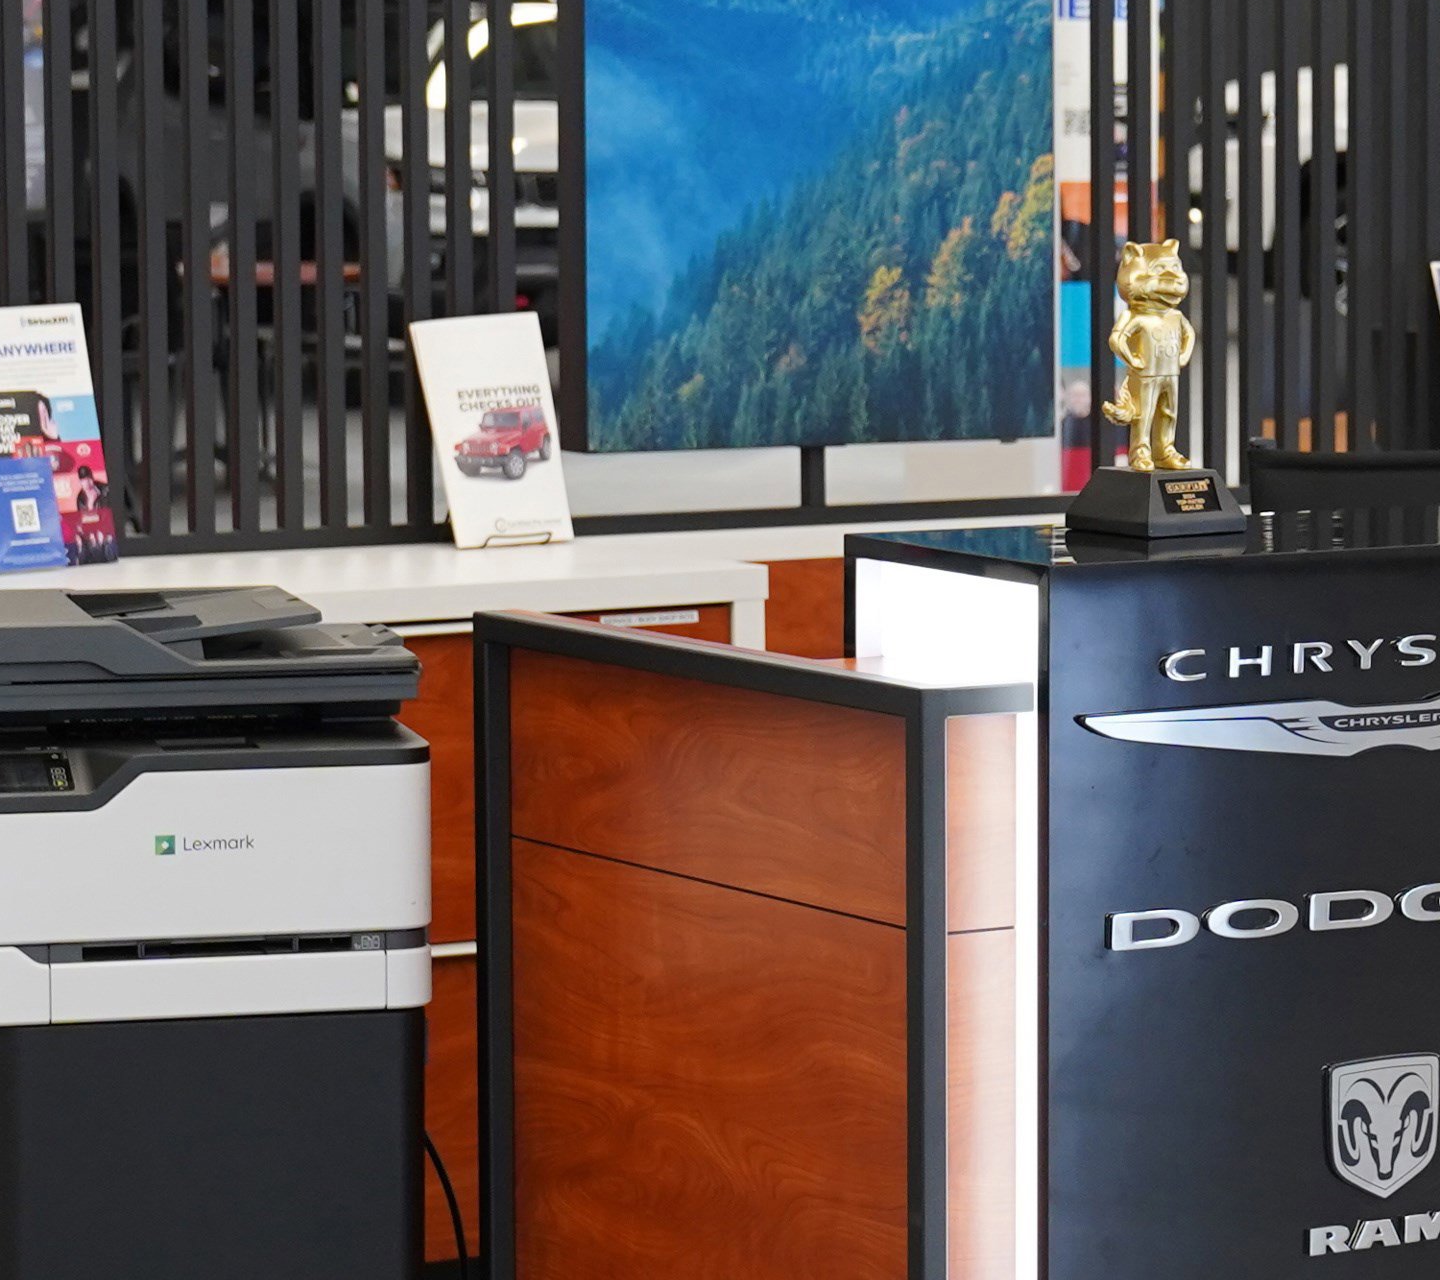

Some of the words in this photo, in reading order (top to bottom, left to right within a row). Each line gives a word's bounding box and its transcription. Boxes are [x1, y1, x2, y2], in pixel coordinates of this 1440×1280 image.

[457, 384, 541, 400] EVERYTHING
[459, 399, 513, 413] CHECKS
[516, 397, 542, 409] OUT
[183, 834, 255, 851] Lexmark
